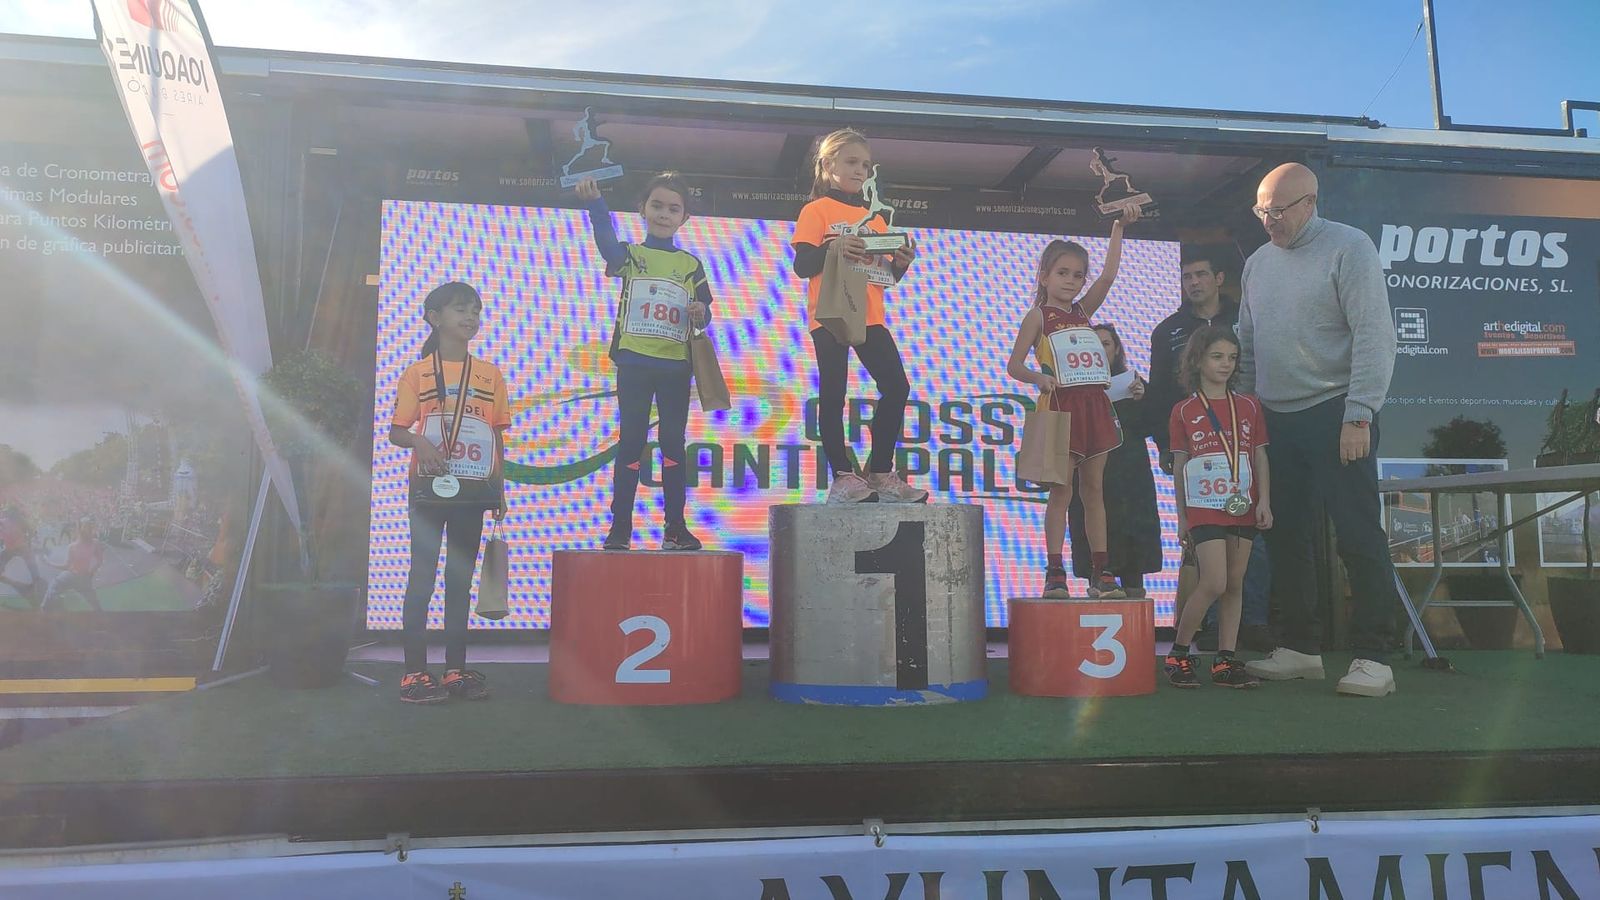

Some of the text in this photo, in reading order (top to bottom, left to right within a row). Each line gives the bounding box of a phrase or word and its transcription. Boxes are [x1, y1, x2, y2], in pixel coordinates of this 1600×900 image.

[16, 162, 38, 178] de
[44, 163, 155, 188] Cronometraj
[406, 168, 461, 182] portos
[49, 188, 138, 206] Modulares
[29, 211, 87, 228] Puntos
[16, 235, 37, 250] de
[1379, 223, 1569, 270] portos
[1384, 273, 1543, 295] ONORIZACIONES,
[639, 301, 681, 325] 180
[1066, 351, 1105, 369] 993
[1429, 396, 1459, 406] Eventos
[1193, 441, 1219, 451] Venta
[855, 521, 928, 691] 1
[615, 615, 671, 683] 2
[1078, 614, 1127, 679] 3
